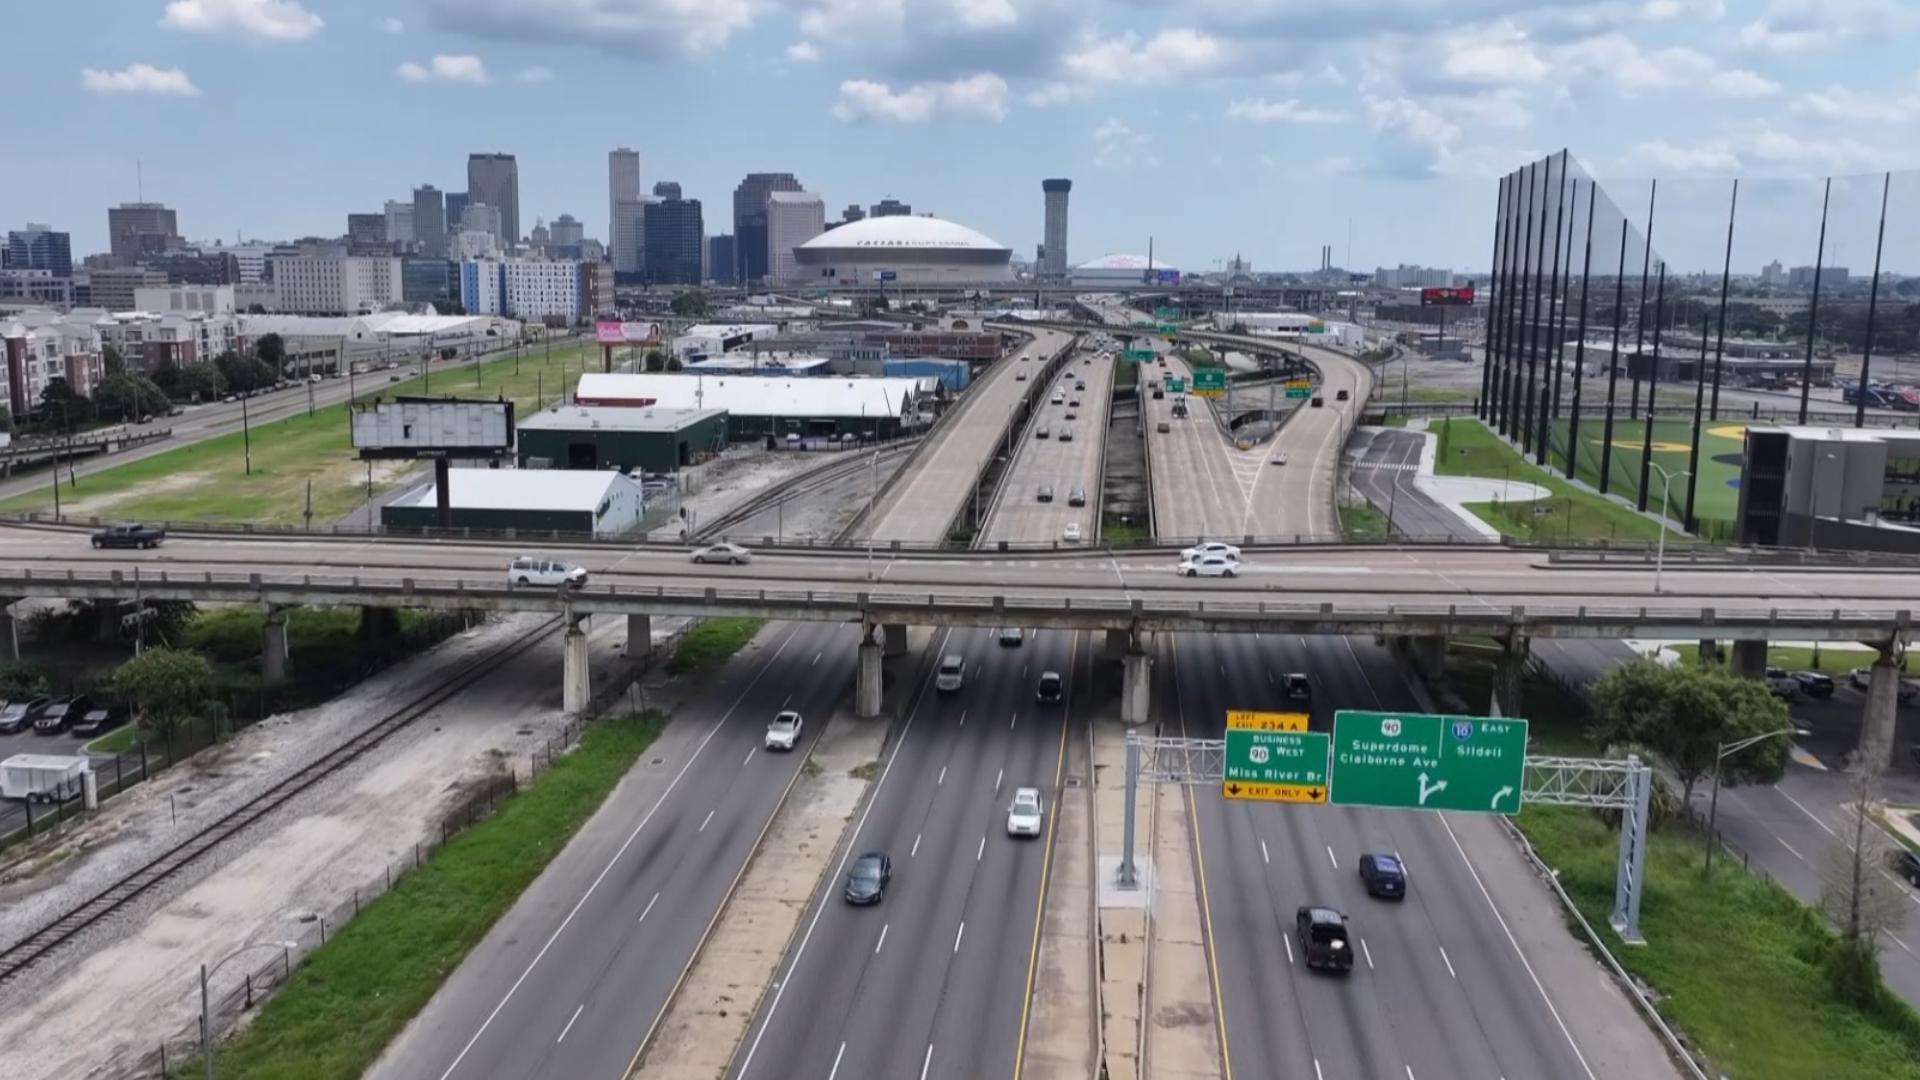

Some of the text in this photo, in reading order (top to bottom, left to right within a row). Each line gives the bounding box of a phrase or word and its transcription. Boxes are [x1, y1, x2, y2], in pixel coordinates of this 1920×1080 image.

[1290, 722, 1298, 731] A
[1384, 722, 1399, 733] 90
[1456, 722, 1510, 737] 10 EAST
[1253, 735, 1302, 745] BUSINESS
[1352, 739, 1428, 754] Superdome
[1251, 747, 1304, 760] 90 WEST
[1457, 744, 1502, 758] Slidell
[1340, 753, 1438, 768] Claiborne Ave
[1228, 767, 1323, 781] Miss River Br
[1248, 787, 1301, 797] EXIT ONLY
